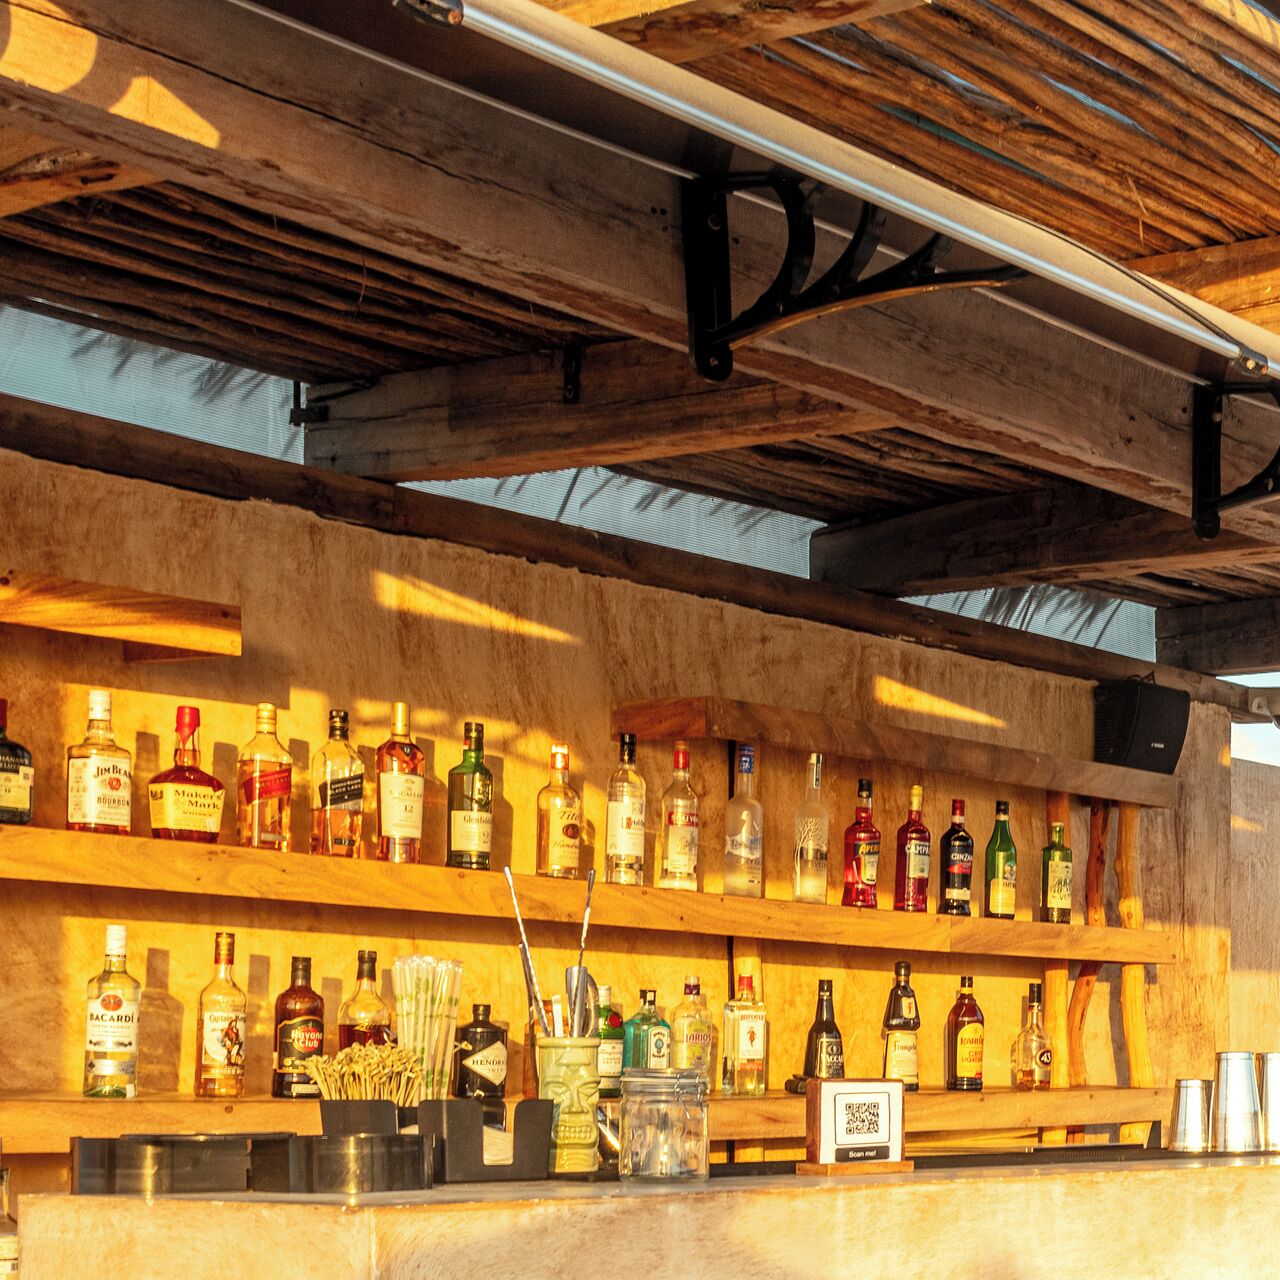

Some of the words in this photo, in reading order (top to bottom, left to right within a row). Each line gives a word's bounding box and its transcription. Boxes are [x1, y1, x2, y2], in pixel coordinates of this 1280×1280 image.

[93, 766, 110, 778] JIM
[187, 800, 220, 809] Mark
[89, 1012, 134, 1023] BACARDÍ
[300, 1040, 319, 1048] Club
[848, 1150, 865, 1158] Scan
